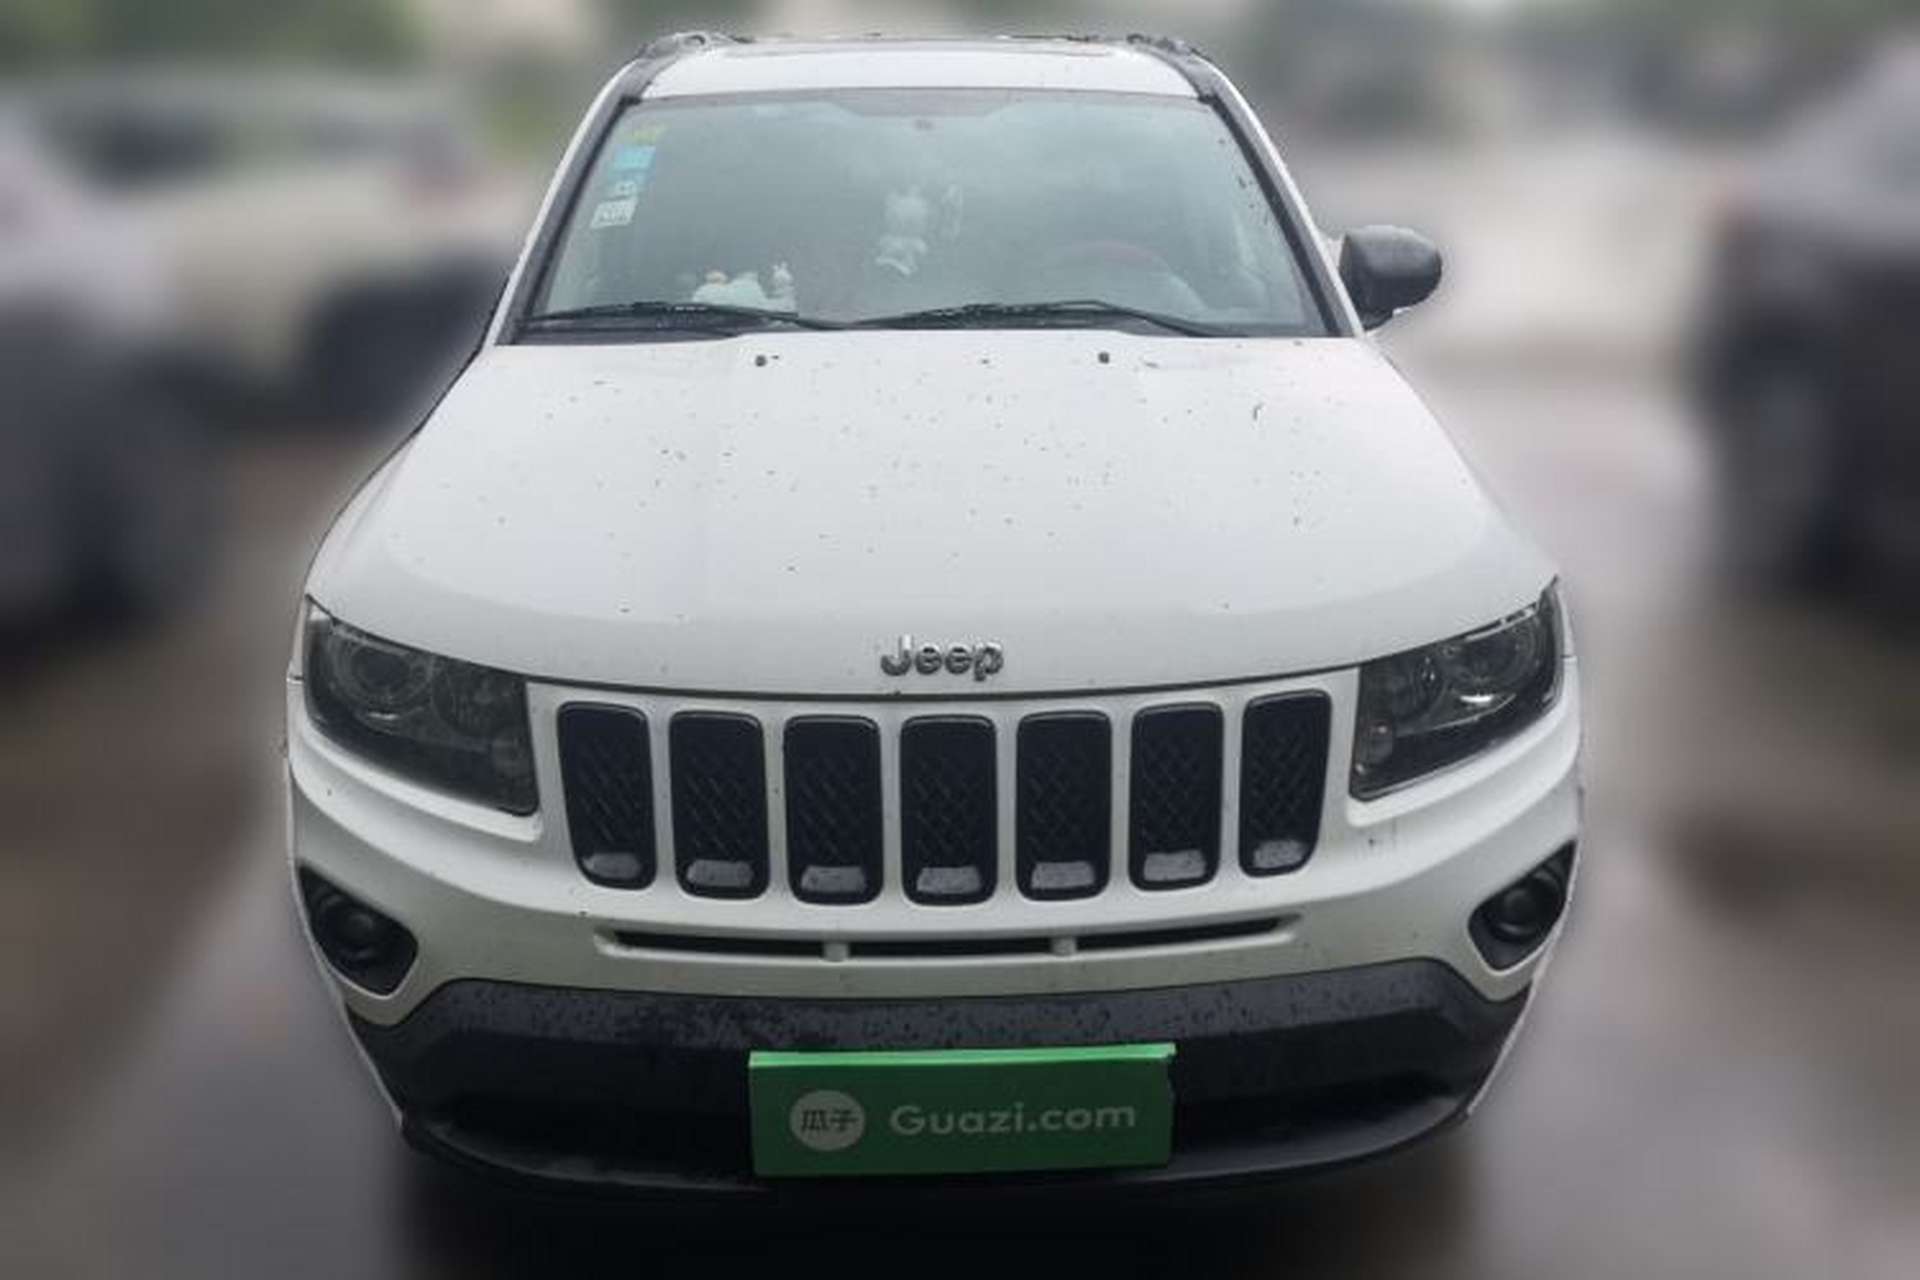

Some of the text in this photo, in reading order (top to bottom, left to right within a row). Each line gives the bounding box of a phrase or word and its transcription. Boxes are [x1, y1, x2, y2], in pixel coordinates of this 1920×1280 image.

[880, 634, 1003, 681] Jeep
[801, 1108, 859, 1134] 瓜子
[889, 1102, 1136, 1135] Guazi.com
